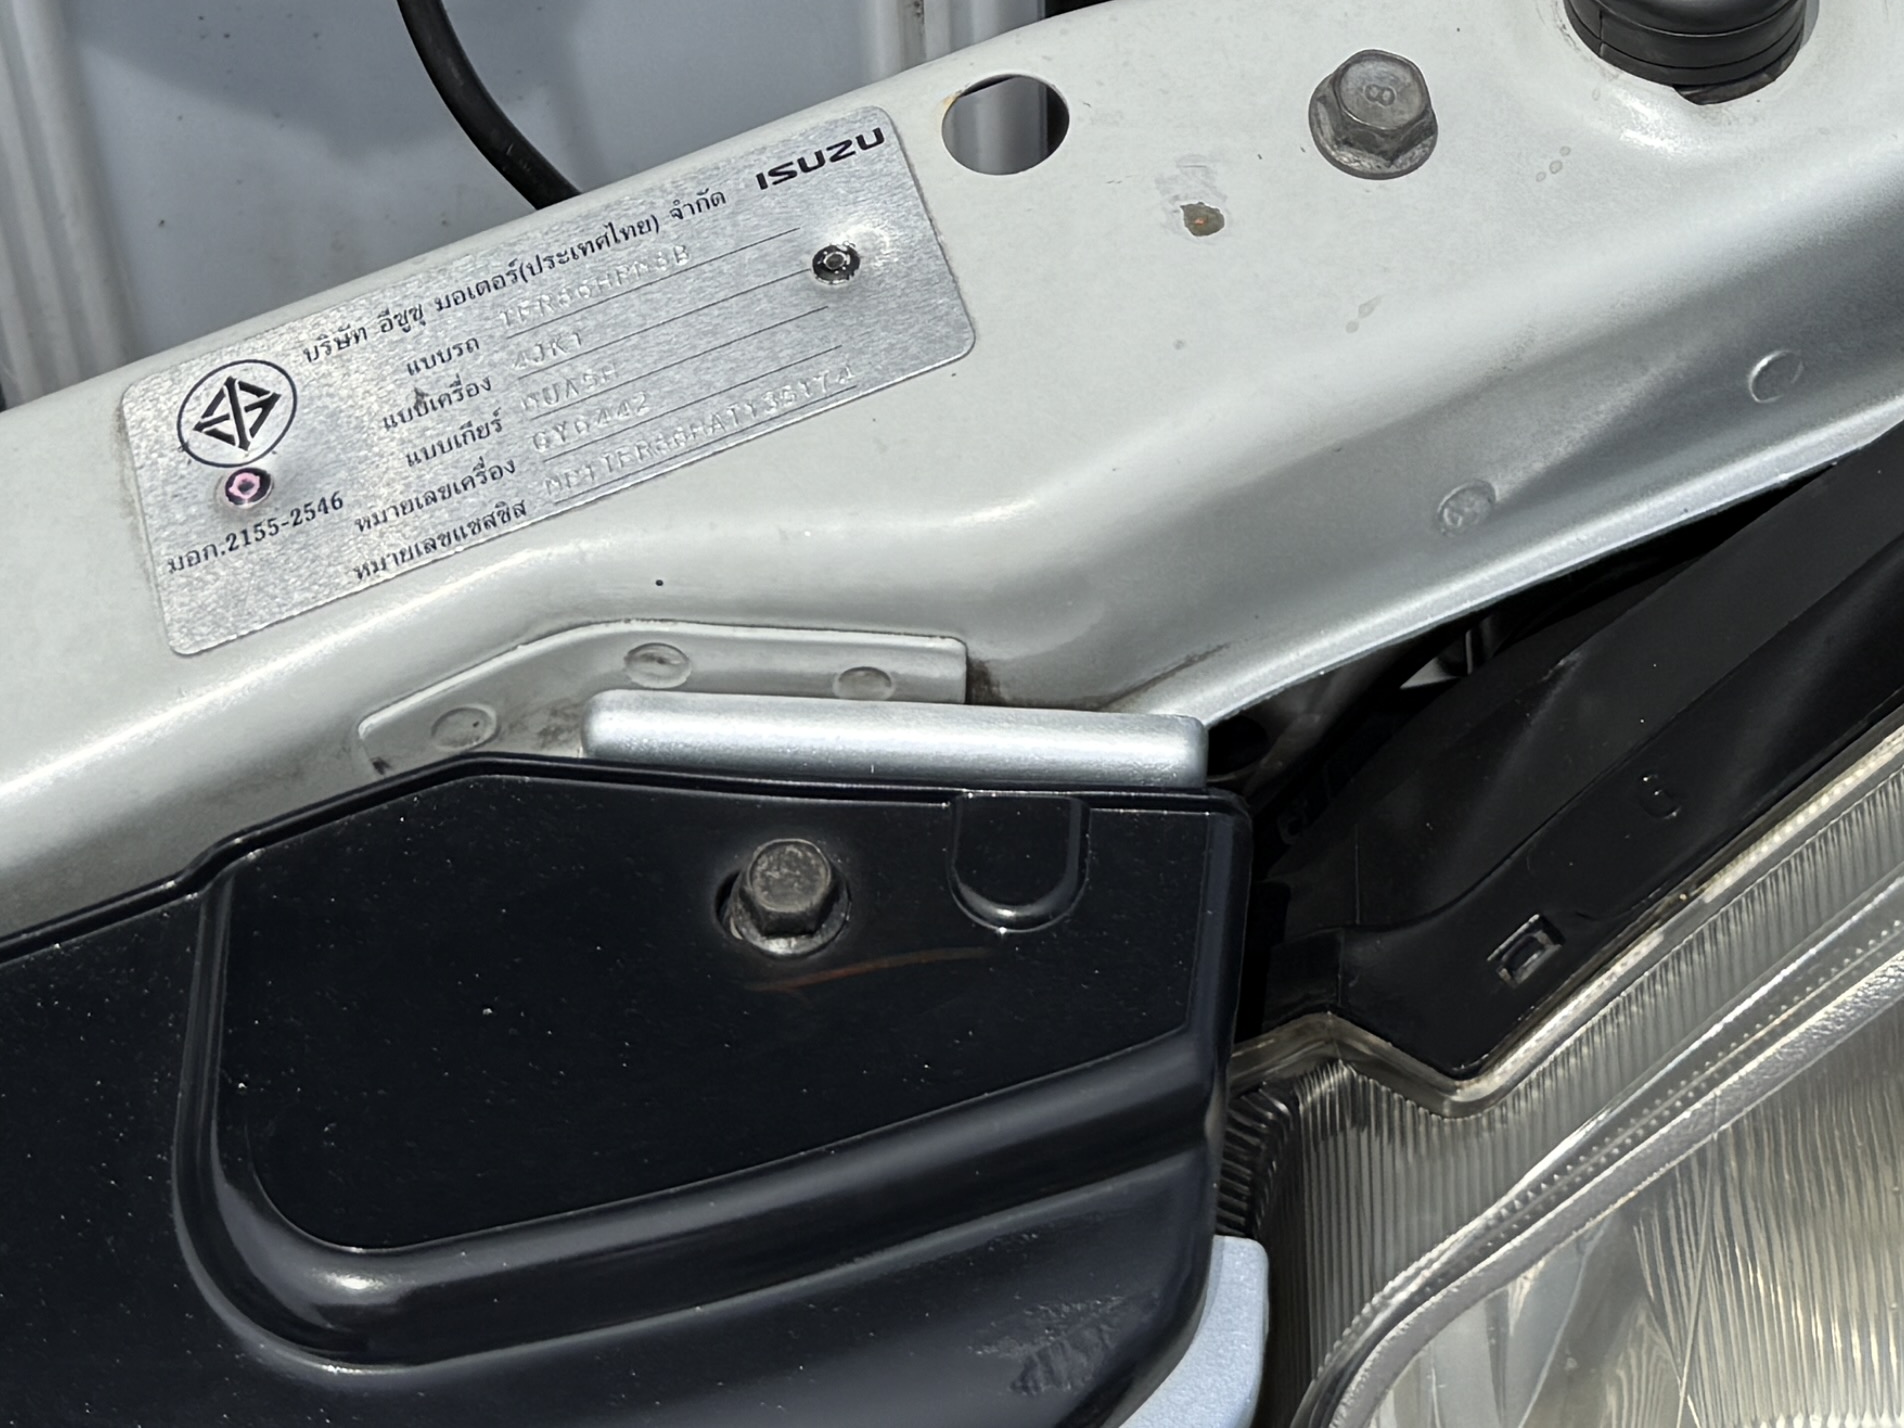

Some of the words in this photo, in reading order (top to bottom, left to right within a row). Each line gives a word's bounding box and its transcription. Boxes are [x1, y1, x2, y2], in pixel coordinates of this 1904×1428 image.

[755, 126, 886, 190] ISUZU
[302, 322, 368, 363] บริษัท
[377, 302, 426, 334] อีซูซุ
[668, 187, 728, 221] จำกัด
[406, 335, 481, 376] แบบรถ
[382, 374, 493, 432] แบบเครื่อง
[405, 407, 504, 468] แบบเกียร์
[354, 456, 518, 534] หมายเลขเครื่อง
[166, 490, 345, 576] มอก.2155-2546
